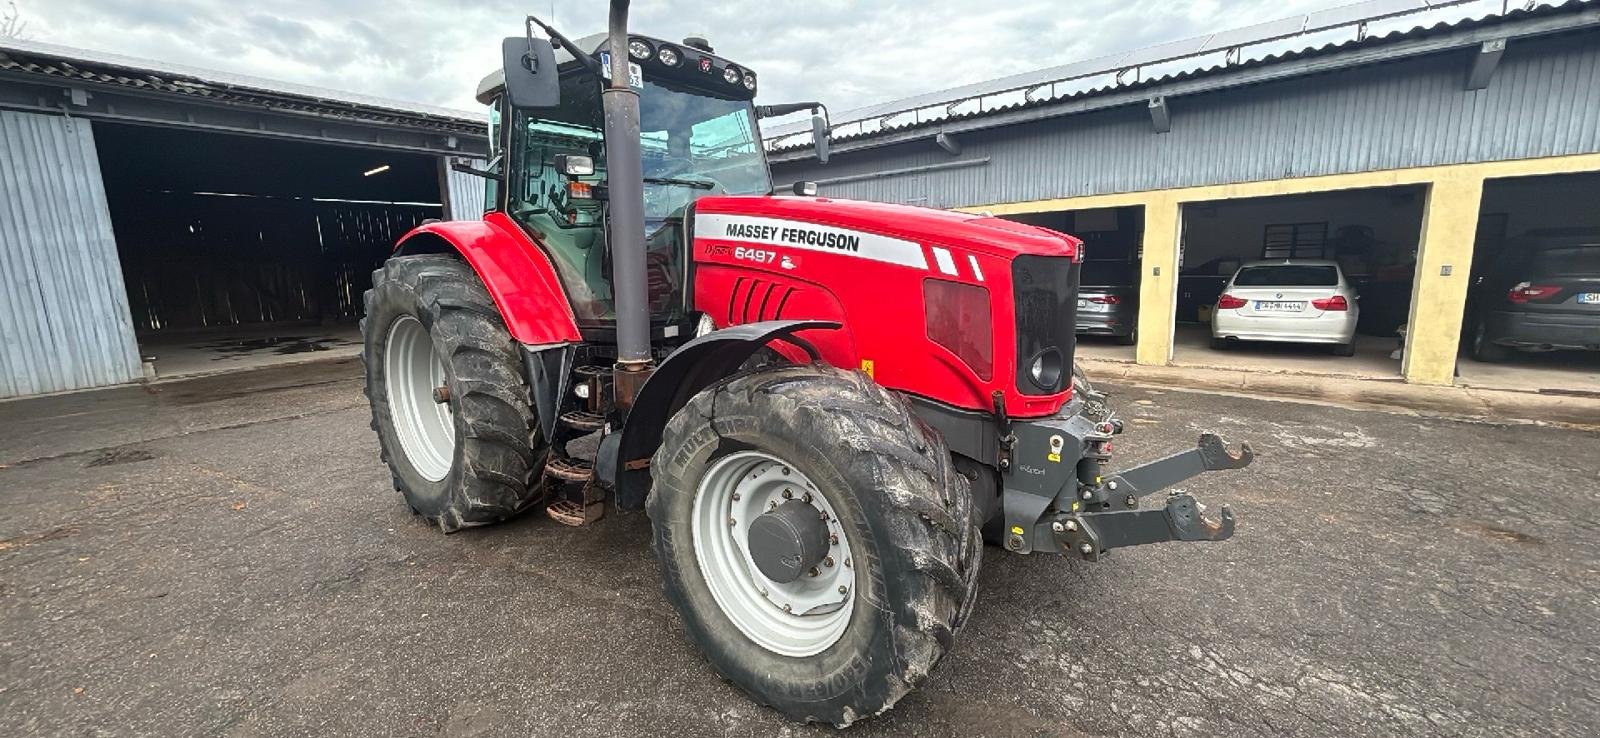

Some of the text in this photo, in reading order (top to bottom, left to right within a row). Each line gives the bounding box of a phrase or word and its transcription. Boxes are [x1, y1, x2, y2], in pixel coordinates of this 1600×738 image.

[726, 223, 860, 252] MASSEY FERGUSON
[734, 246, 776, 264] 6497
